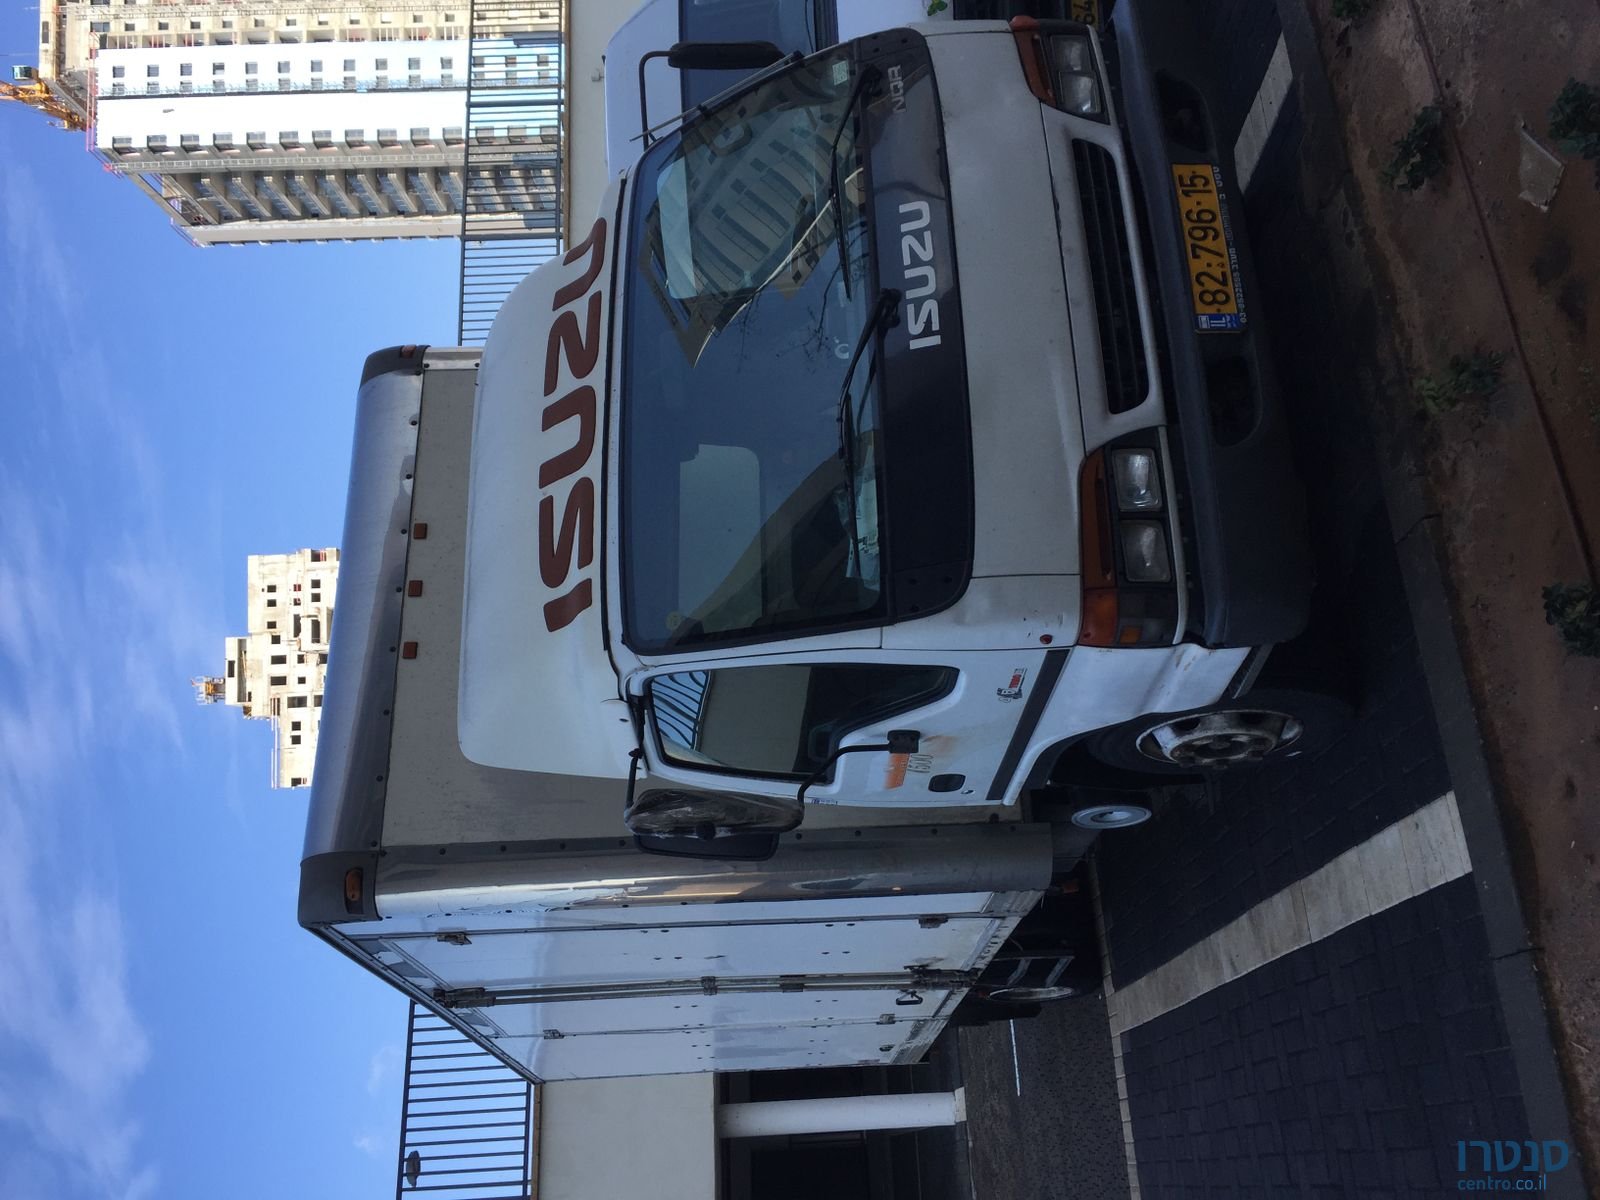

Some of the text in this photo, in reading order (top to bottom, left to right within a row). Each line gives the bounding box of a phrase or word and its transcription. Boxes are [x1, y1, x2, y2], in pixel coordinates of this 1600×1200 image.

[887, 64, 906, 114] NQR
[898, 200, 942, 350] ISUZU
[1210, 316, 1226, 327] IL
[538, 217, 607, 633] ISUZU
